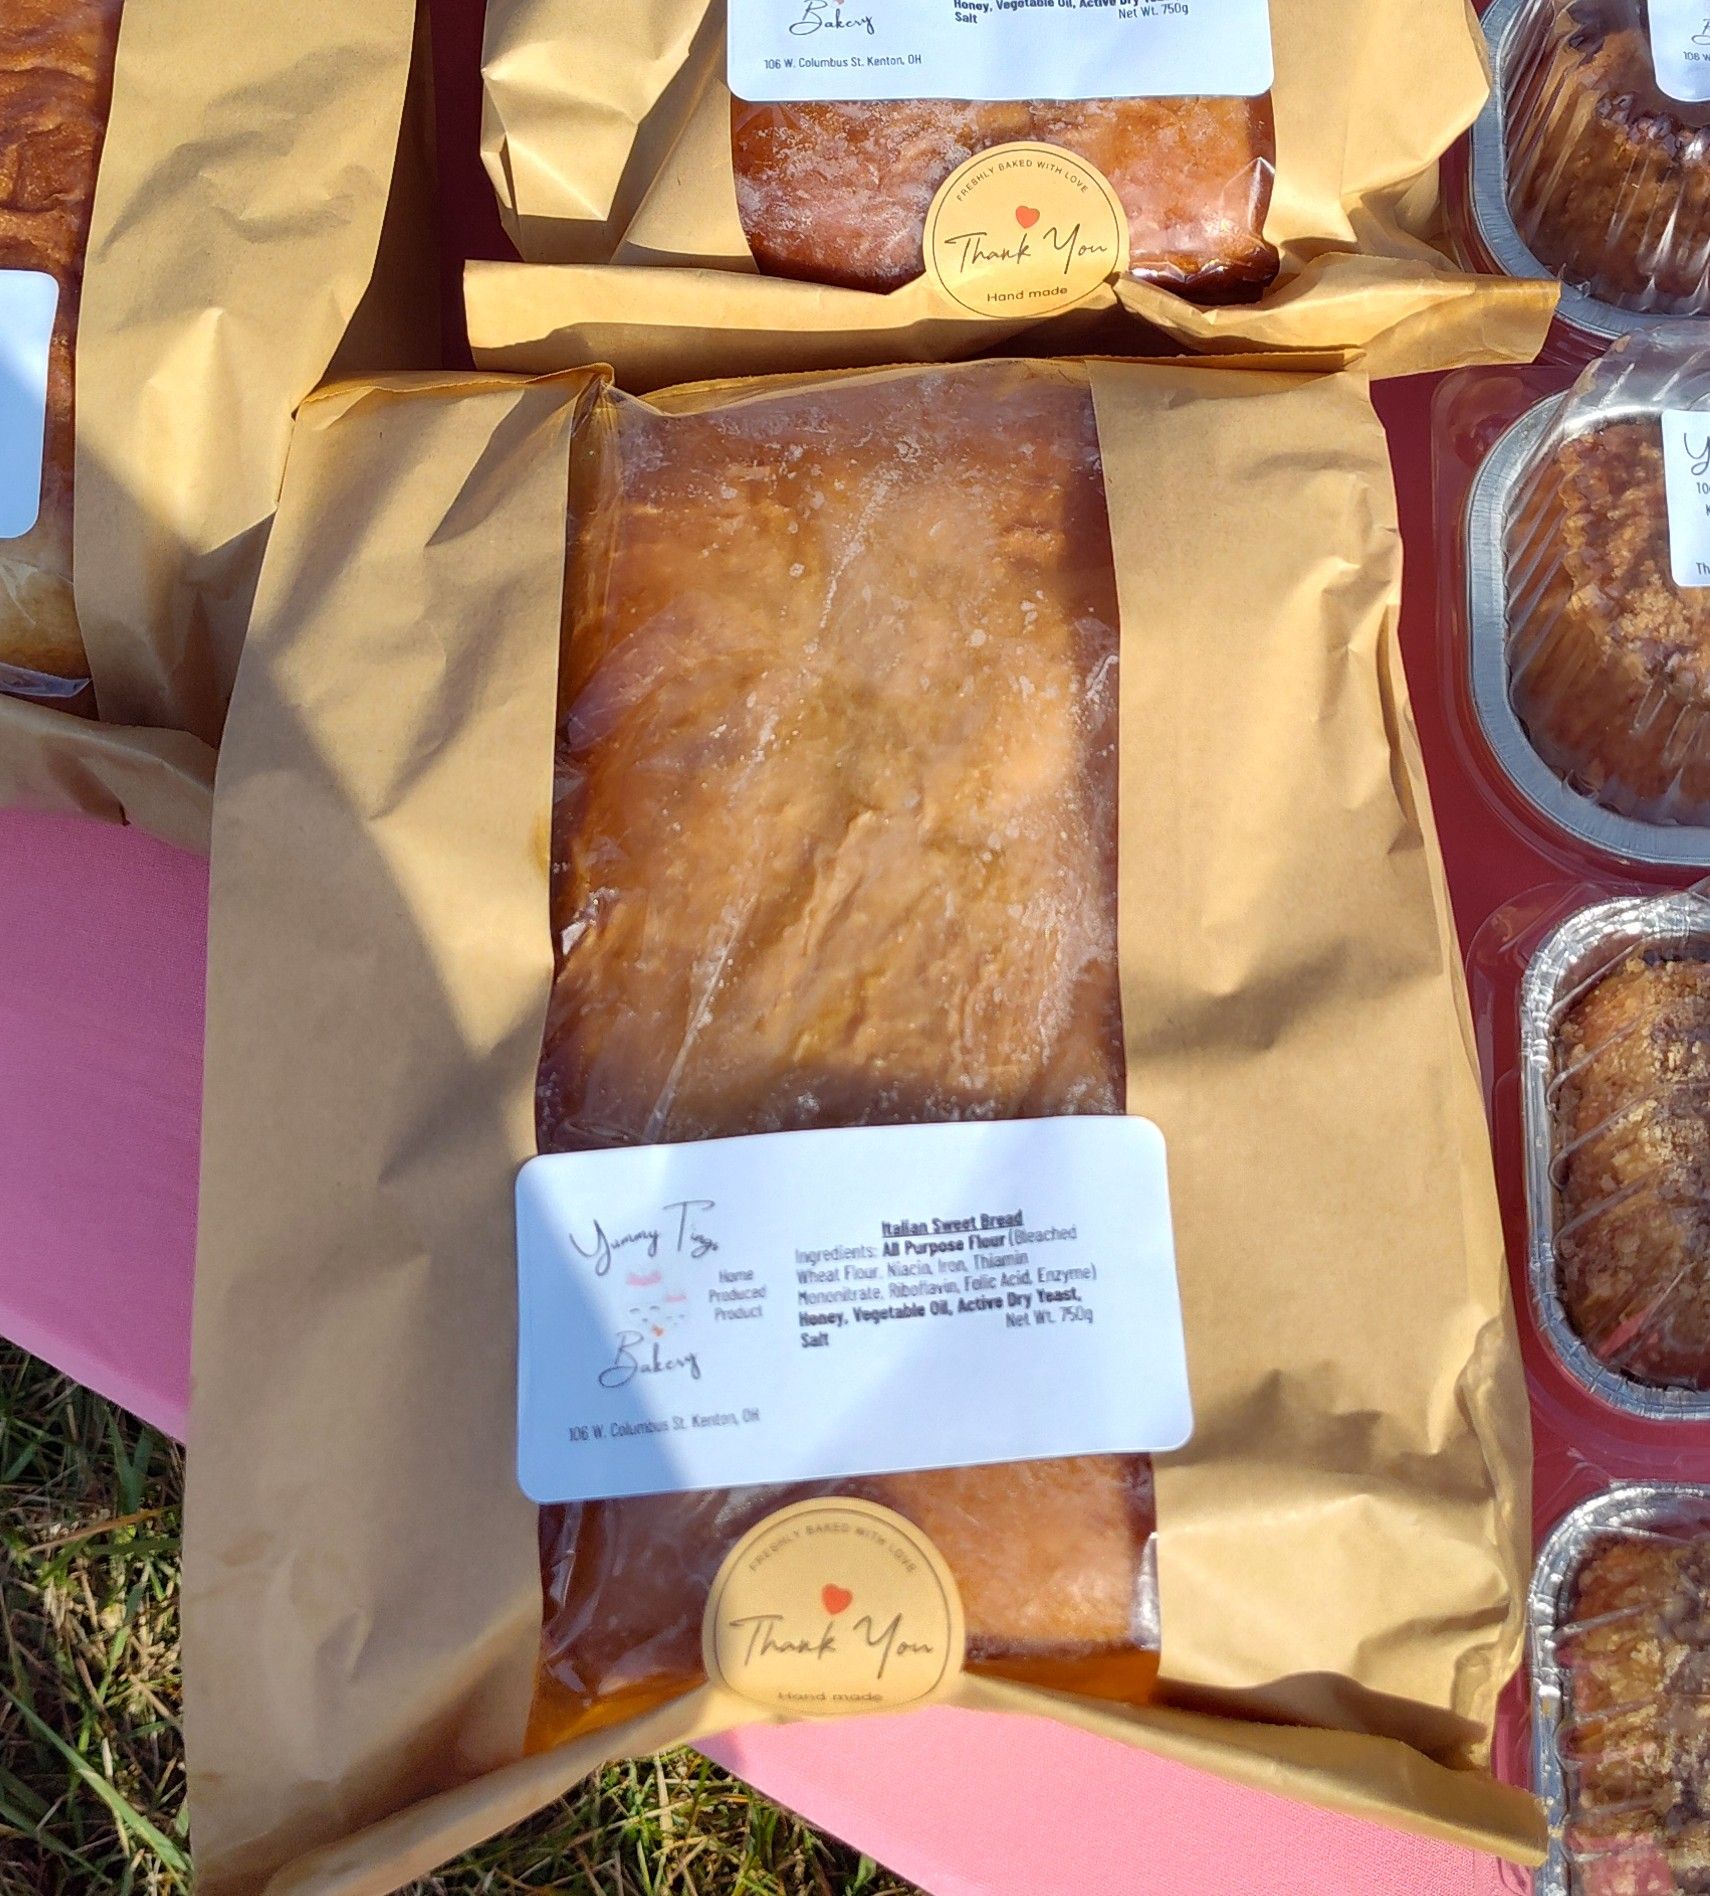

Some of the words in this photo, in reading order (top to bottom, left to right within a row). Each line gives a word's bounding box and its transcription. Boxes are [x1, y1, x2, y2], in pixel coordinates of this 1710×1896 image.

[789, 0, 875, 35] Bakery
[954, 12, 978, 24] Salt
[1118, 9, 1137, 20] Net
[1162, 3, 1189, 16] 750g
[764, 59, 781, 69] 106
[784, 58, 796, 68] W.
[799, 57, 849, 68] Columbus
[850, 56, 864, 67] St.
[867, 55, 905, 67] Kenton,
[907, 54, 922, 65] OH
[956, 168, 995, 202] FRESHLY
[998, 159, 1033, 172] BAKED
[1037, 161, 1063, 175] WITH
[1064, 172, 1089, 194] LOVE
[944, 231, 1031, 274] Thank
[1042, 223, 1108, 275] You
[987, 290, 1024, 303] Hand
[1028, 286, 1068, 299] made
[881, 1219, 929, 1237] Italian
[932, 1216, 977, 1234] Sweet
[979, 1208, 1024, 1229] Bread
[569, 1219, 661, 1277] Yummy
[795, 1244, 878, 1267] Ingredients:
[882, 1241, 900, 1257] All
[904, 1239, 965, 1257] Purpose
[968, 1234, 1006, 1250] Flour
[1008, 1224, 1078, 1247] (Bleached
[718, 1269, 754, 1283] Home
[796, 1268, 840, 1284] Wheat
[973, 1250, 1029, 1270] Thiamin
[963, 1274, 997, 1291] Folic
[1037, 1262, 1098, 1284] Enzyme)
[708, 1284, 767, 1303] Produced
[799, 1311, 848, 1328] Honey,
[852, 1302, 926, 1325] Vegetable
[929, 1299, 953, 1316] Oil,
[957, 1294, 1004, 1313] Active
[1006, 1291, 1032, 1309] Dry
[1036, 1287, 1082, 1303] Yeast,
[714, 1304, 763, 1321] Product
[800, 1331, 829, 1348] Salt
[1005, 1312, 1031, 1328] Net
[1060, 1305, 1094, 1324] 750g
[598, 1330, 702, 1389] Bakery
[568, 1427, 589, 1442] 106
[610, 1421, 669, 1438] Columbus
[691, 1413, 739, 1429] Kenton,
[742, 1407, 760, 1423] OH
[748, 1530, 802, 1573] FRESHLY
[805, 1522, 850, 1537] BAKED
[856, 1524, 887, 1546] WITH
[887, 1541, 918, 1574] LOVE
[729, 1613, 837, 1667] Thank
[852, 1612, 934, 1681] You
[778, 1691, 827, 1702] Hand
[832, 1691, 884, 1703] made
